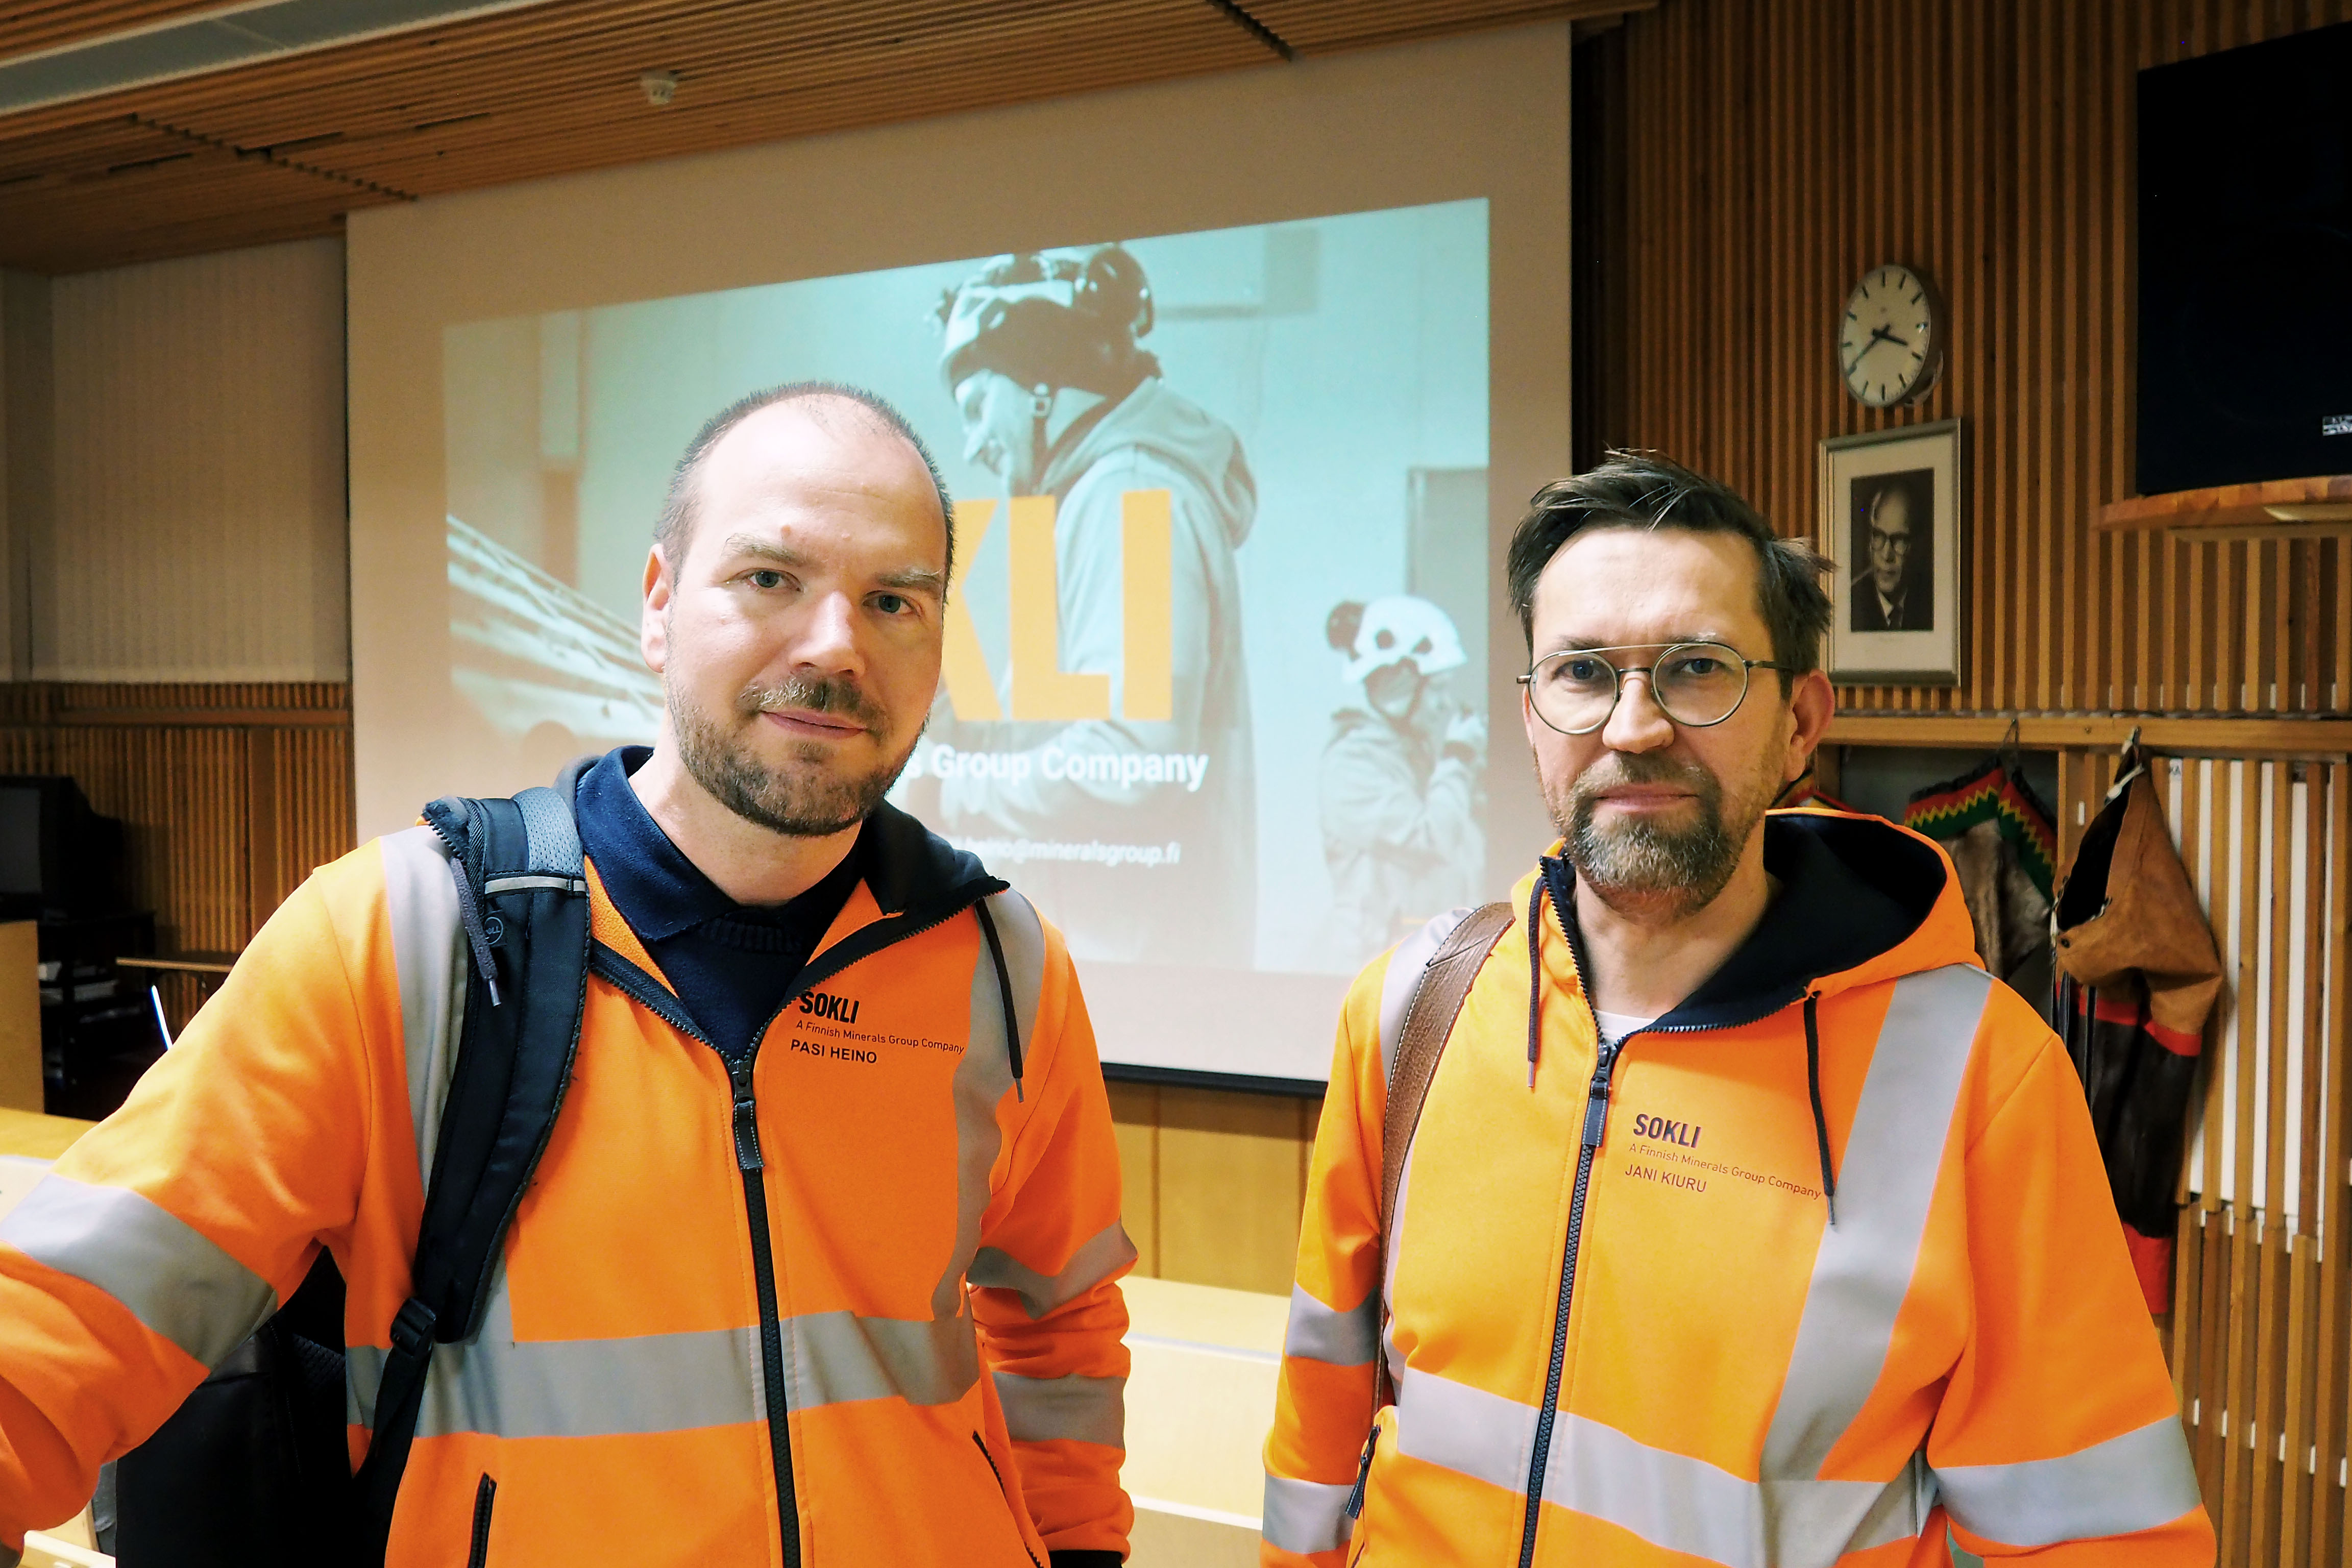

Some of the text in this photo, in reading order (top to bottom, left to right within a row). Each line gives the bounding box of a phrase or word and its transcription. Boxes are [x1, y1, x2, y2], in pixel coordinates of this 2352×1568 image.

[941, 489, 1173, 721] KLI
[932, 743, 1031, 786] Group
[1041, 746, 1208, 792] Company
[799, 991, 860, 1024] SOKLI
[791, 1039, 877, 1064] PASI HEINO
[796, 1020, 965, 1055] A Finnish Minerals Group Company
[1633, 1113, 1701, 1148] SOKLI
[1625, 1164, 1707, 1192] JANI KIURU
[1629, 1143, 1822, 1200] A Finnish Minerals Group Company
